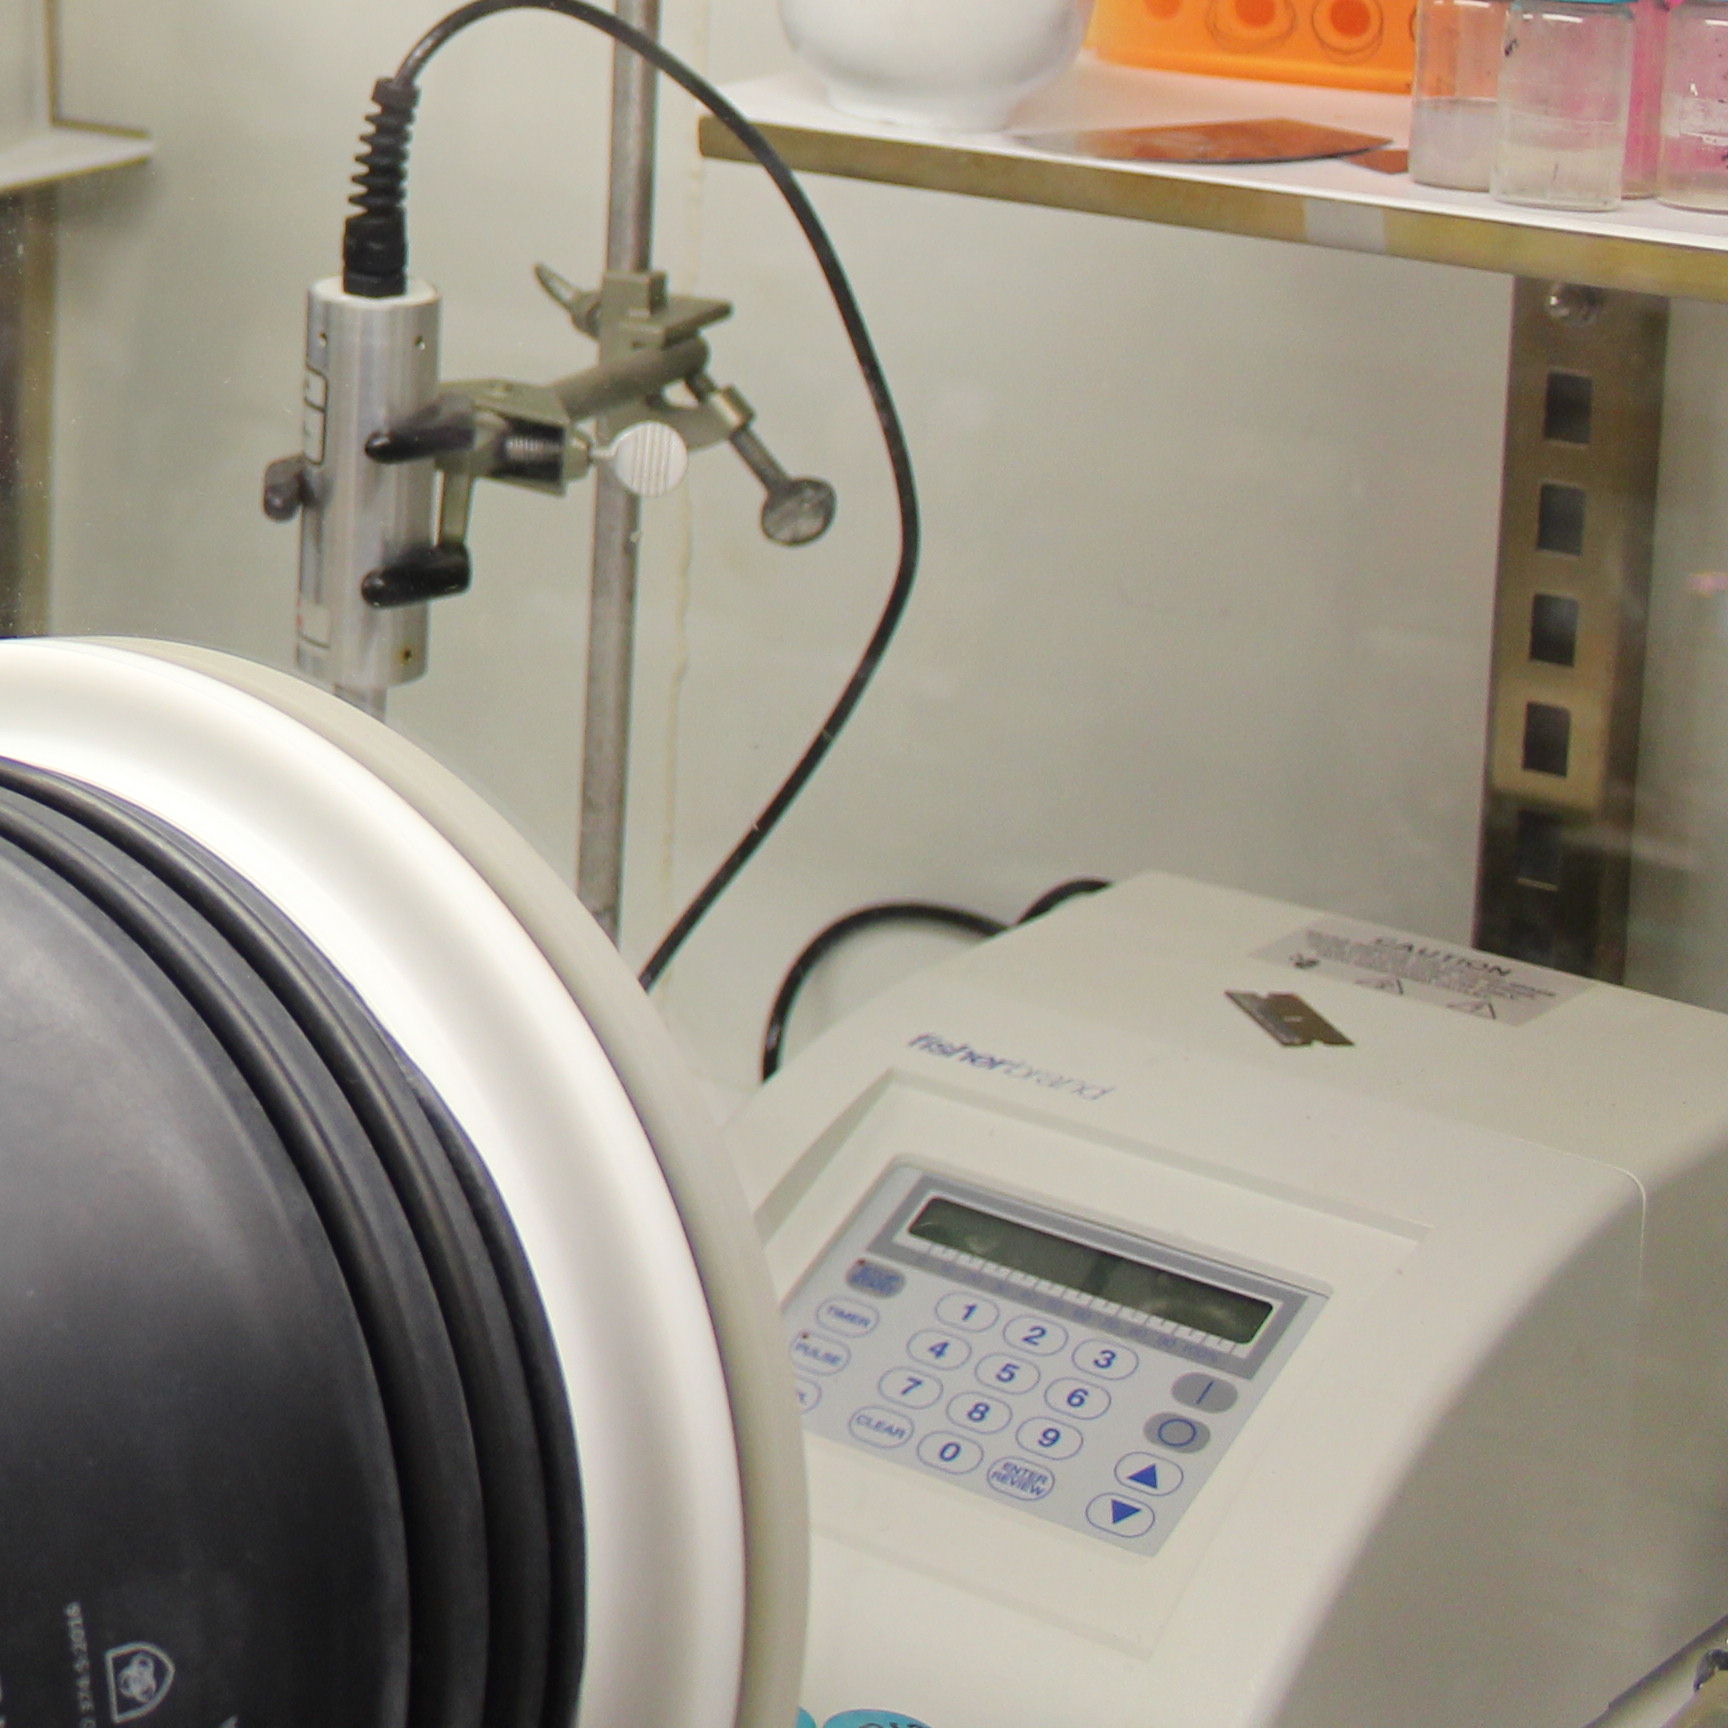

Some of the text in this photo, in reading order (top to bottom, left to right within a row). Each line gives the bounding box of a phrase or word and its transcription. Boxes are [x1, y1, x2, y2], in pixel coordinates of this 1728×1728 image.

[961, 1303, 979, 1322] 1
[1021, 1325, 1047, 1347] 2
[928, 1341, 951, 1359] 4
[1093, 1349, 1117, 1369] 3
[995, 1362, 1021, 1384] 5
[900, 1376, 924, 1397] 7
[1066, 1387, 1091, 1409] 6
[966, 1401, 992, 1423] 8
[855, 1414, 907, 1440] CLEAR
[1037, 1427, 1062, 1448] 9
[938, 1441, 962, 1463] 0
[990, 1470, 1046, 1497] REVIEW
[1002, 1460, 1049, 1485] ENTER
